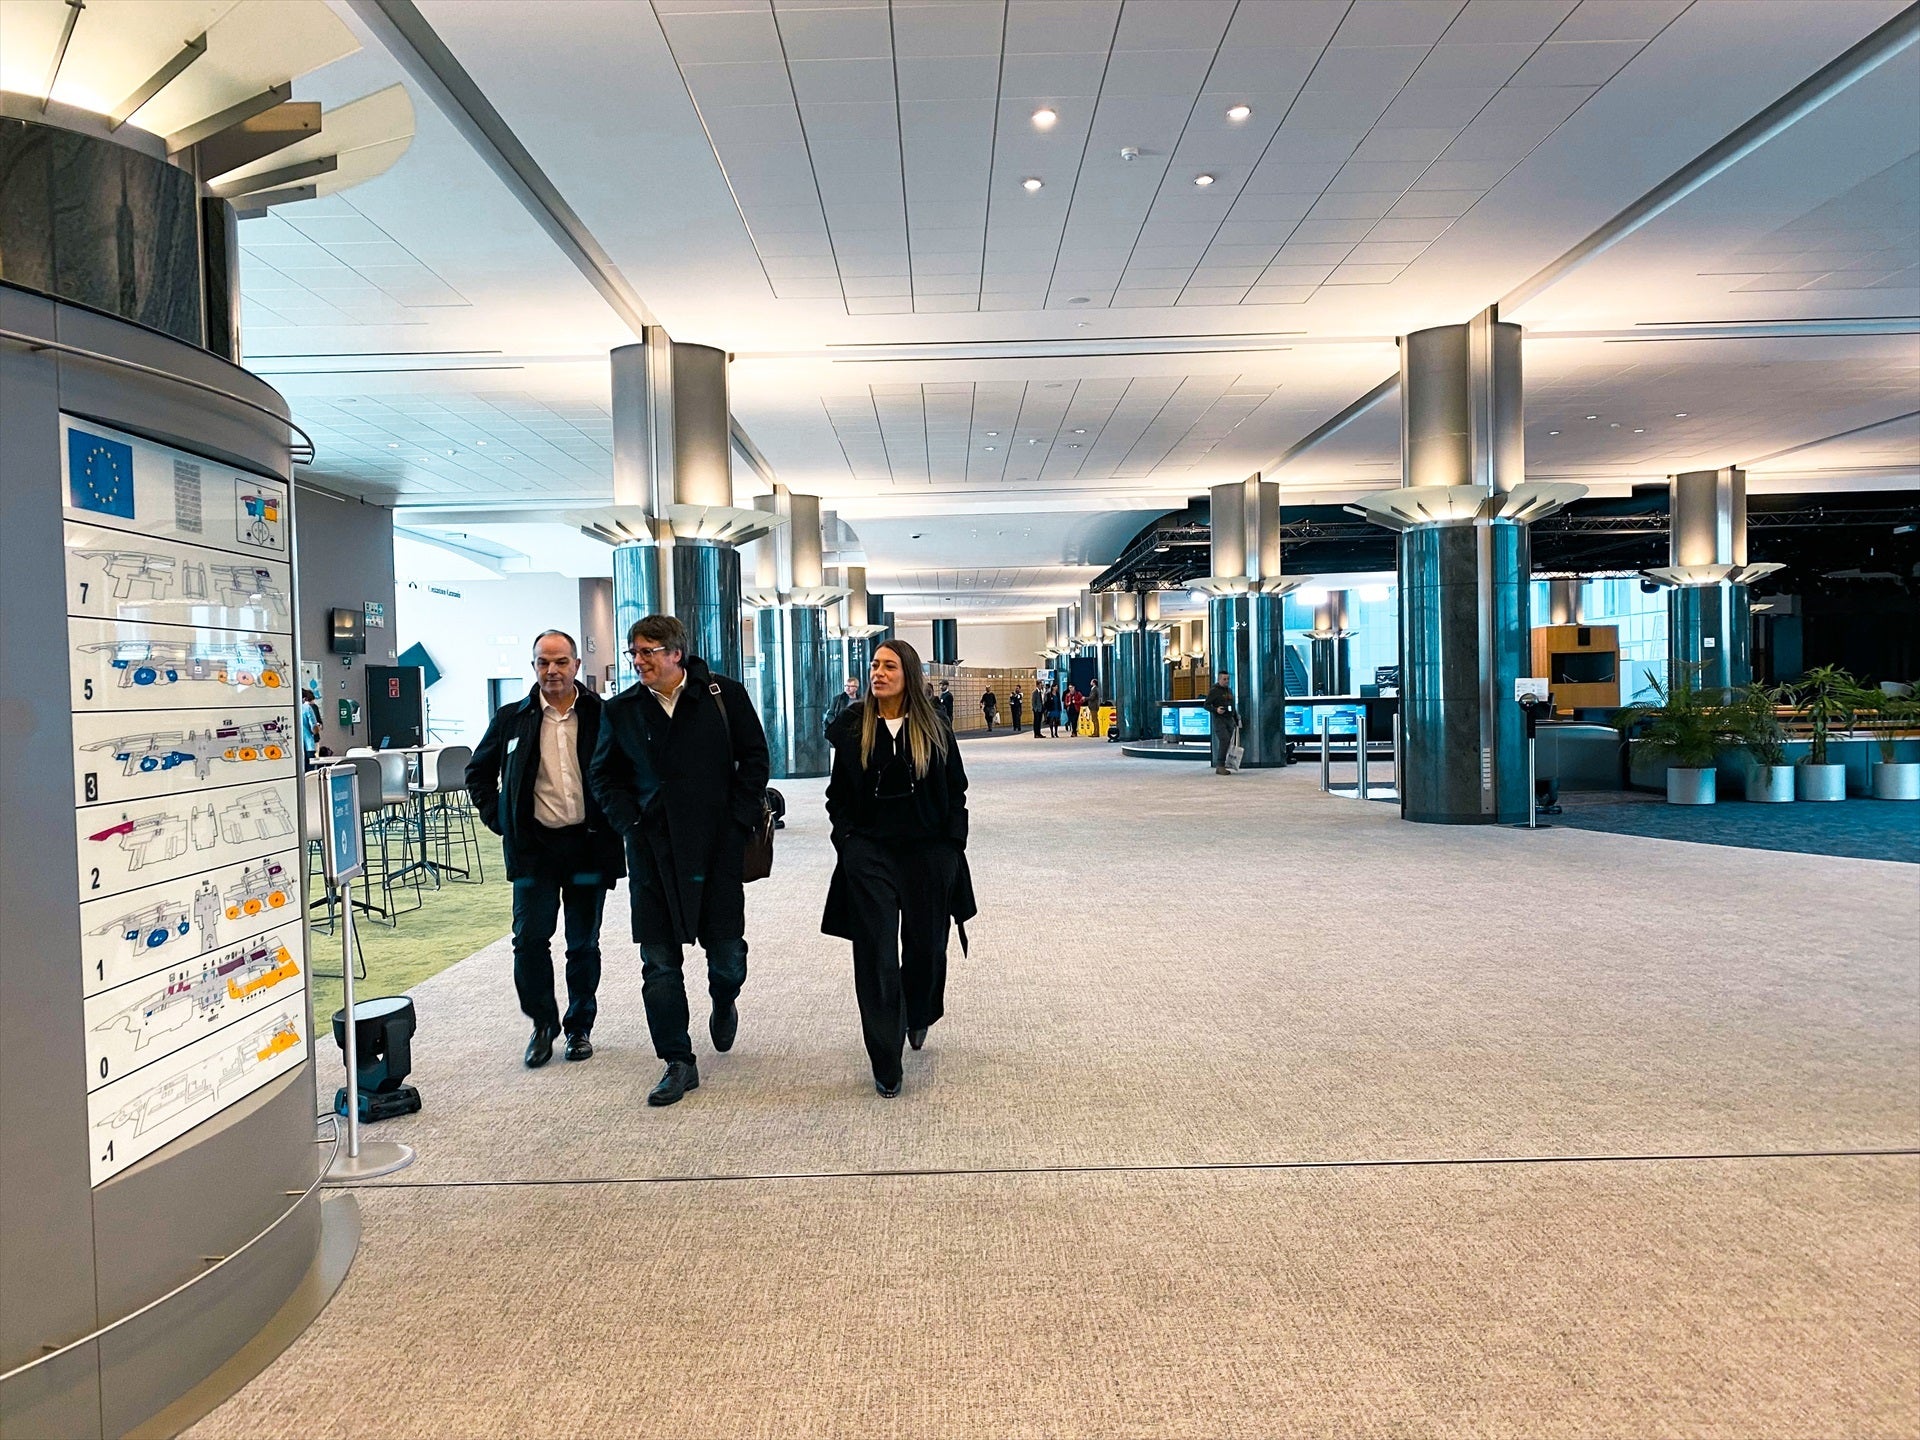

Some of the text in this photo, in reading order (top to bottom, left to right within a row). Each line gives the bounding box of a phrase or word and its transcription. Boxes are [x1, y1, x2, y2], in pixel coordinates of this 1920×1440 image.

[80, 583, 89, 605] 7
[84, 679, 93, 701] 5
[87, 776, 96, 798] 3
[91, 867, 101, 890] 2
[96, 960, 104, 981] 1
[100, 1056, 109, 1079] 0
[101, 1140, 114, 1162] -1
